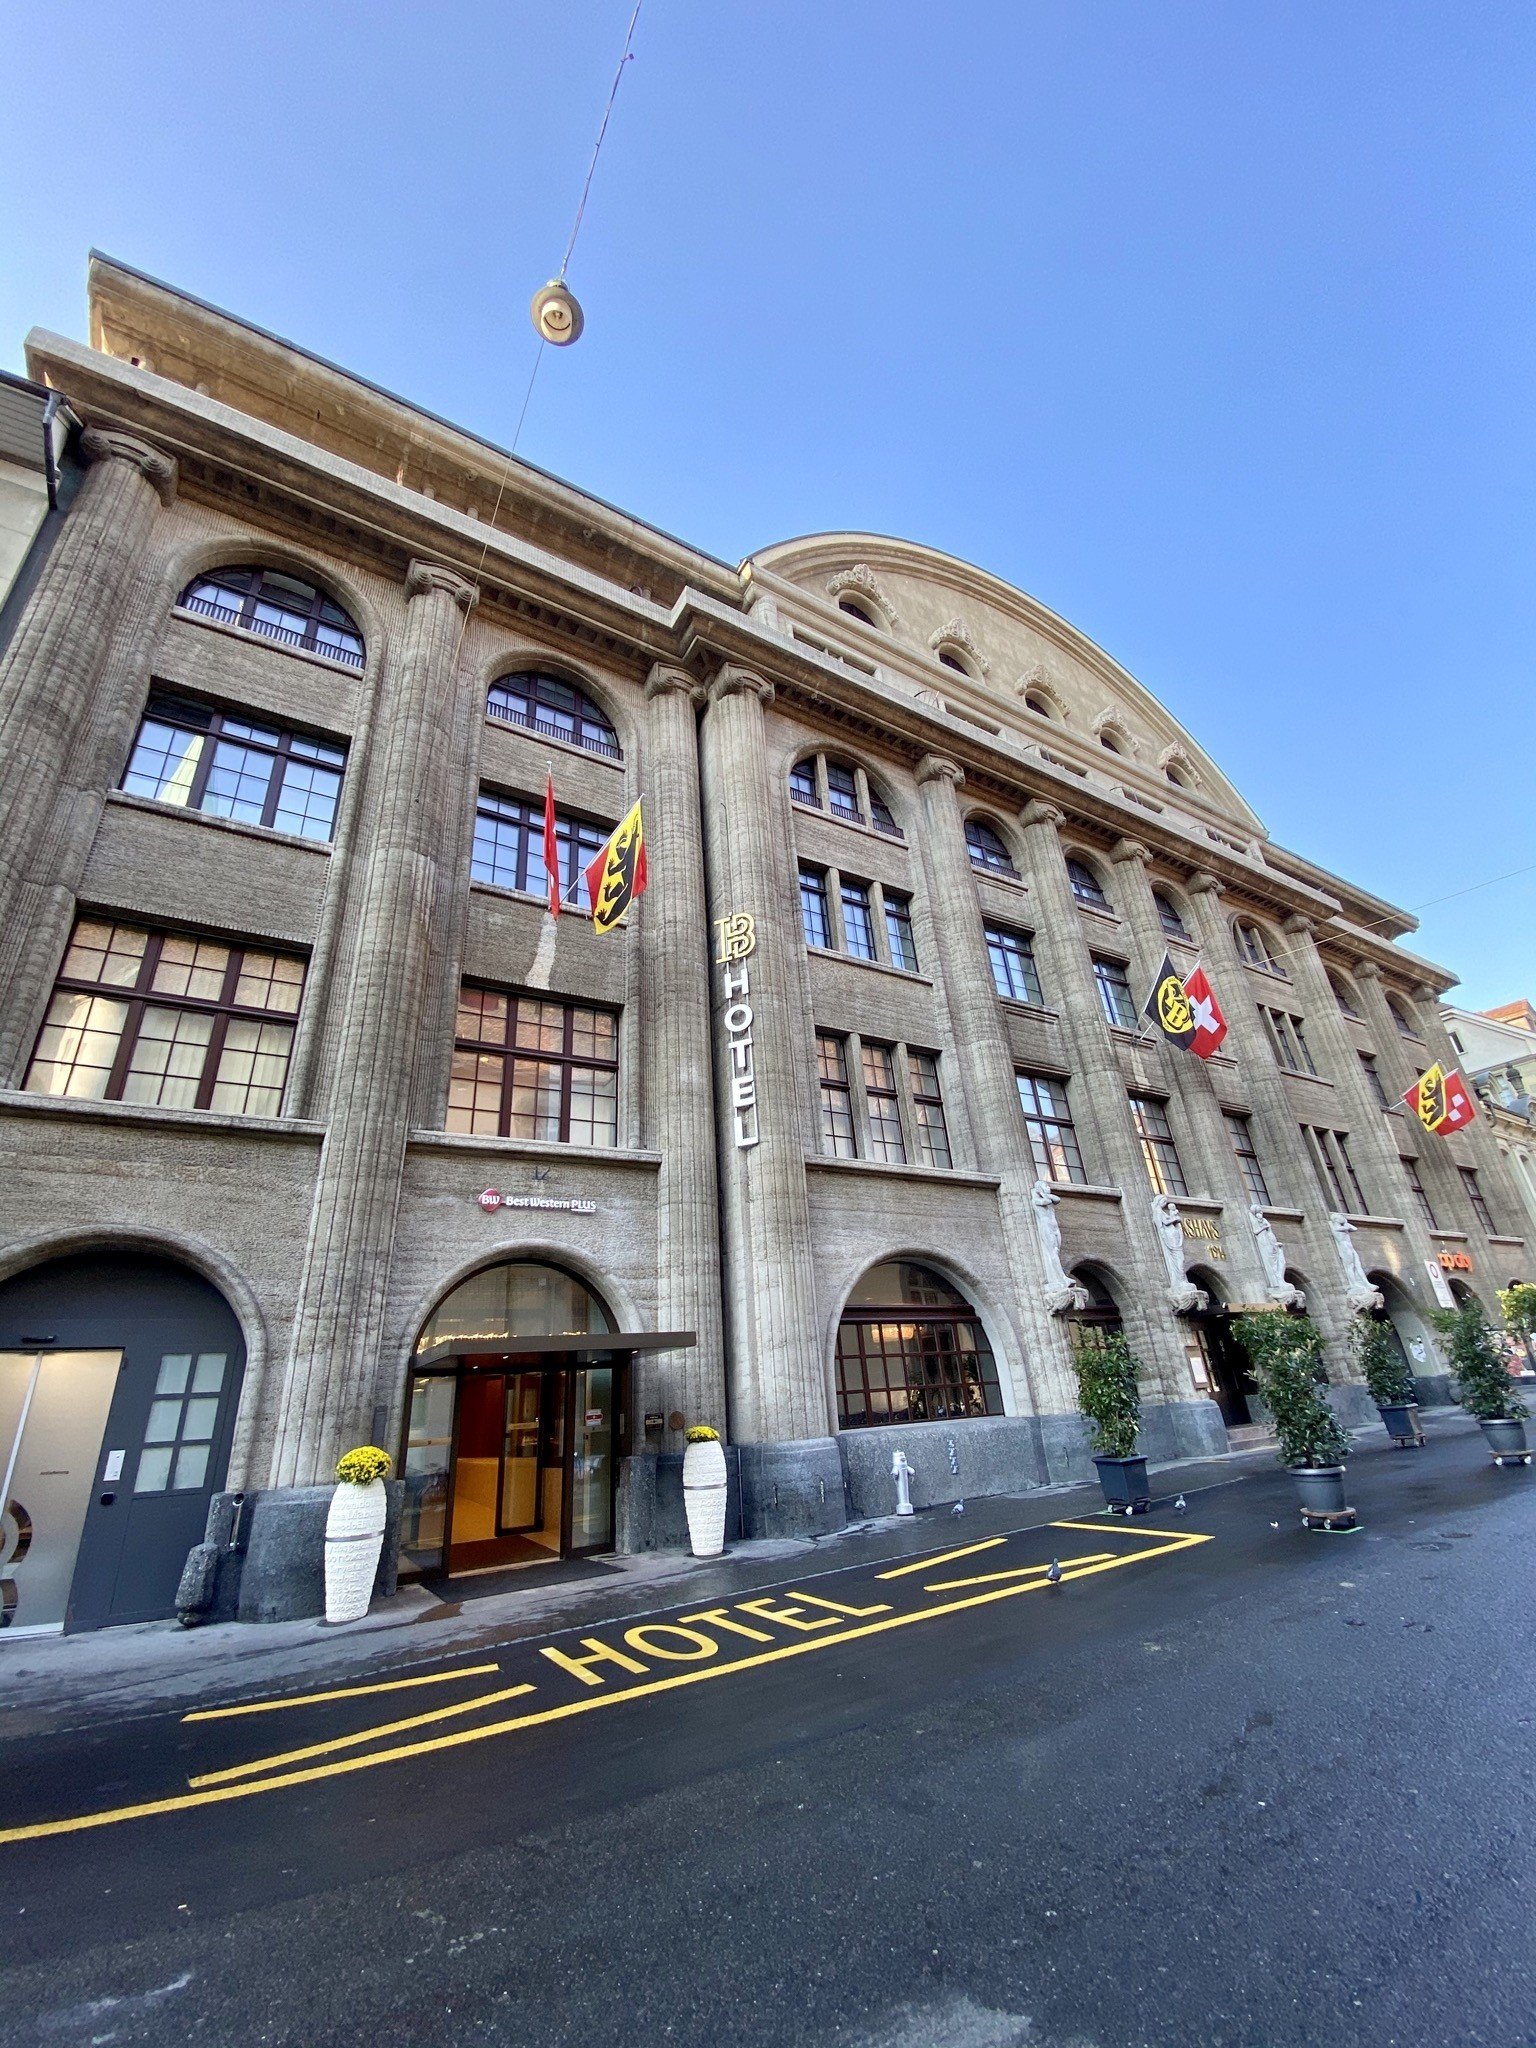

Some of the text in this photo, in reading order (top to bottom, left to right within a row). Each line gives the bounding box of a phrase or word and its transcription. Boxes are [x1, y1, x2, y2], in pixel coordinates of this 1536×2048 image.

[723, 967, 760, 1148] HOTEL
[505, 1195, 597, 1212] Best Western PLUS
[539, 1591, 895, 1686] HOTEL
